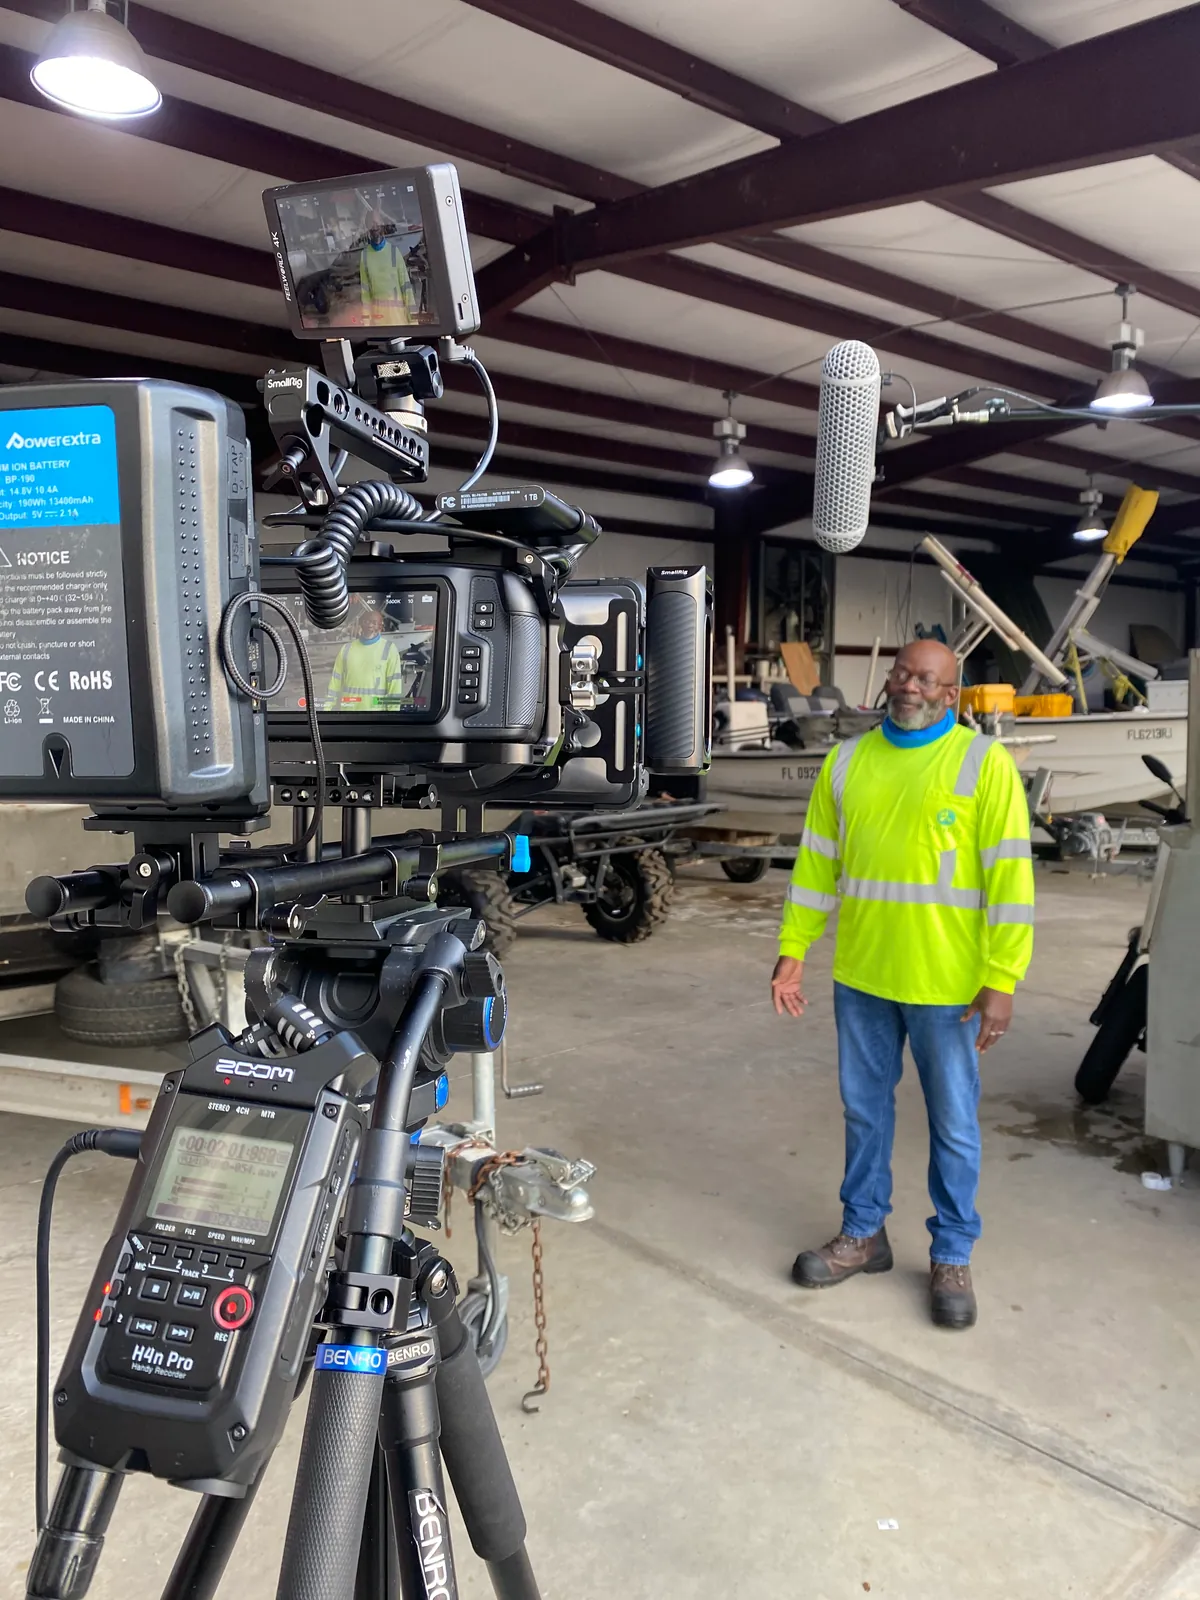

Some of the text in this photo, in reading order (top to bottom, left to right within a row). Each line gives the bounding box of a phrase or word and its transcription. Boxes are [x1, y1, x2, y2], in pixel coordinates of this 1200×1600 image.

[271, 231, 280, 248] 4K
[267, 377, 303, 389] SmallRig
[11, 462, 27, 471] ION
[29, 460, 71, 471] BATTERY
[5, 474, 35, 484] BP-190
[529, 493, 538, 501] TB
[31, 510, 42, 519] 5V
[17, 551, 70, 566] NOTICE
[46, 571, 55, 579] be
[56, 570, 84, 579] followed
[86, 570, 108, 579] strictly
[16, 583, 64, 592] recommended
[22, 607, 46, 616] battery
[46, 606, 63, 615] pack
[64, 606, 82, 615] away
[57, 617, 66, 625] or
[66, 616, 99, 625] assemble
[100, 615, 112, 624] the
[39, 640, 68, 650] puncture
[78, 640, 96, 648] short
[22, 652, 50, 660] contacts
[69, 670, 113, 691] RoHS
[62, 715, 115, 724] MADE IN CHINA
[215, 1058, 295, 1083] ZOOM
[207, 1102, 276, 1119] STEREO 4CH MTR
[155, 1223, 176, 1233] FOLDER
[184, 1228, 196, 1236] FILE
[207, 1231, 226, 1241] SPEED
[134, 1261, 147, 1271] MIC
[151, 1255, 235, 1279] 1 2 3 4
[181, 1268, 200, 1279] TRACK
[127, 1286, 132, 1296] 1
[116, 1313, 123, 1324] 2
[214, 1331, 229, 1342] REC
[131, 1343, 194, 1371] H4n Pro
[323, 1348, 382, 1369] BENRO
[387, 1342, 431, 1364] BENRO
[131, 1362, 187, 1380] Handy Recorder
